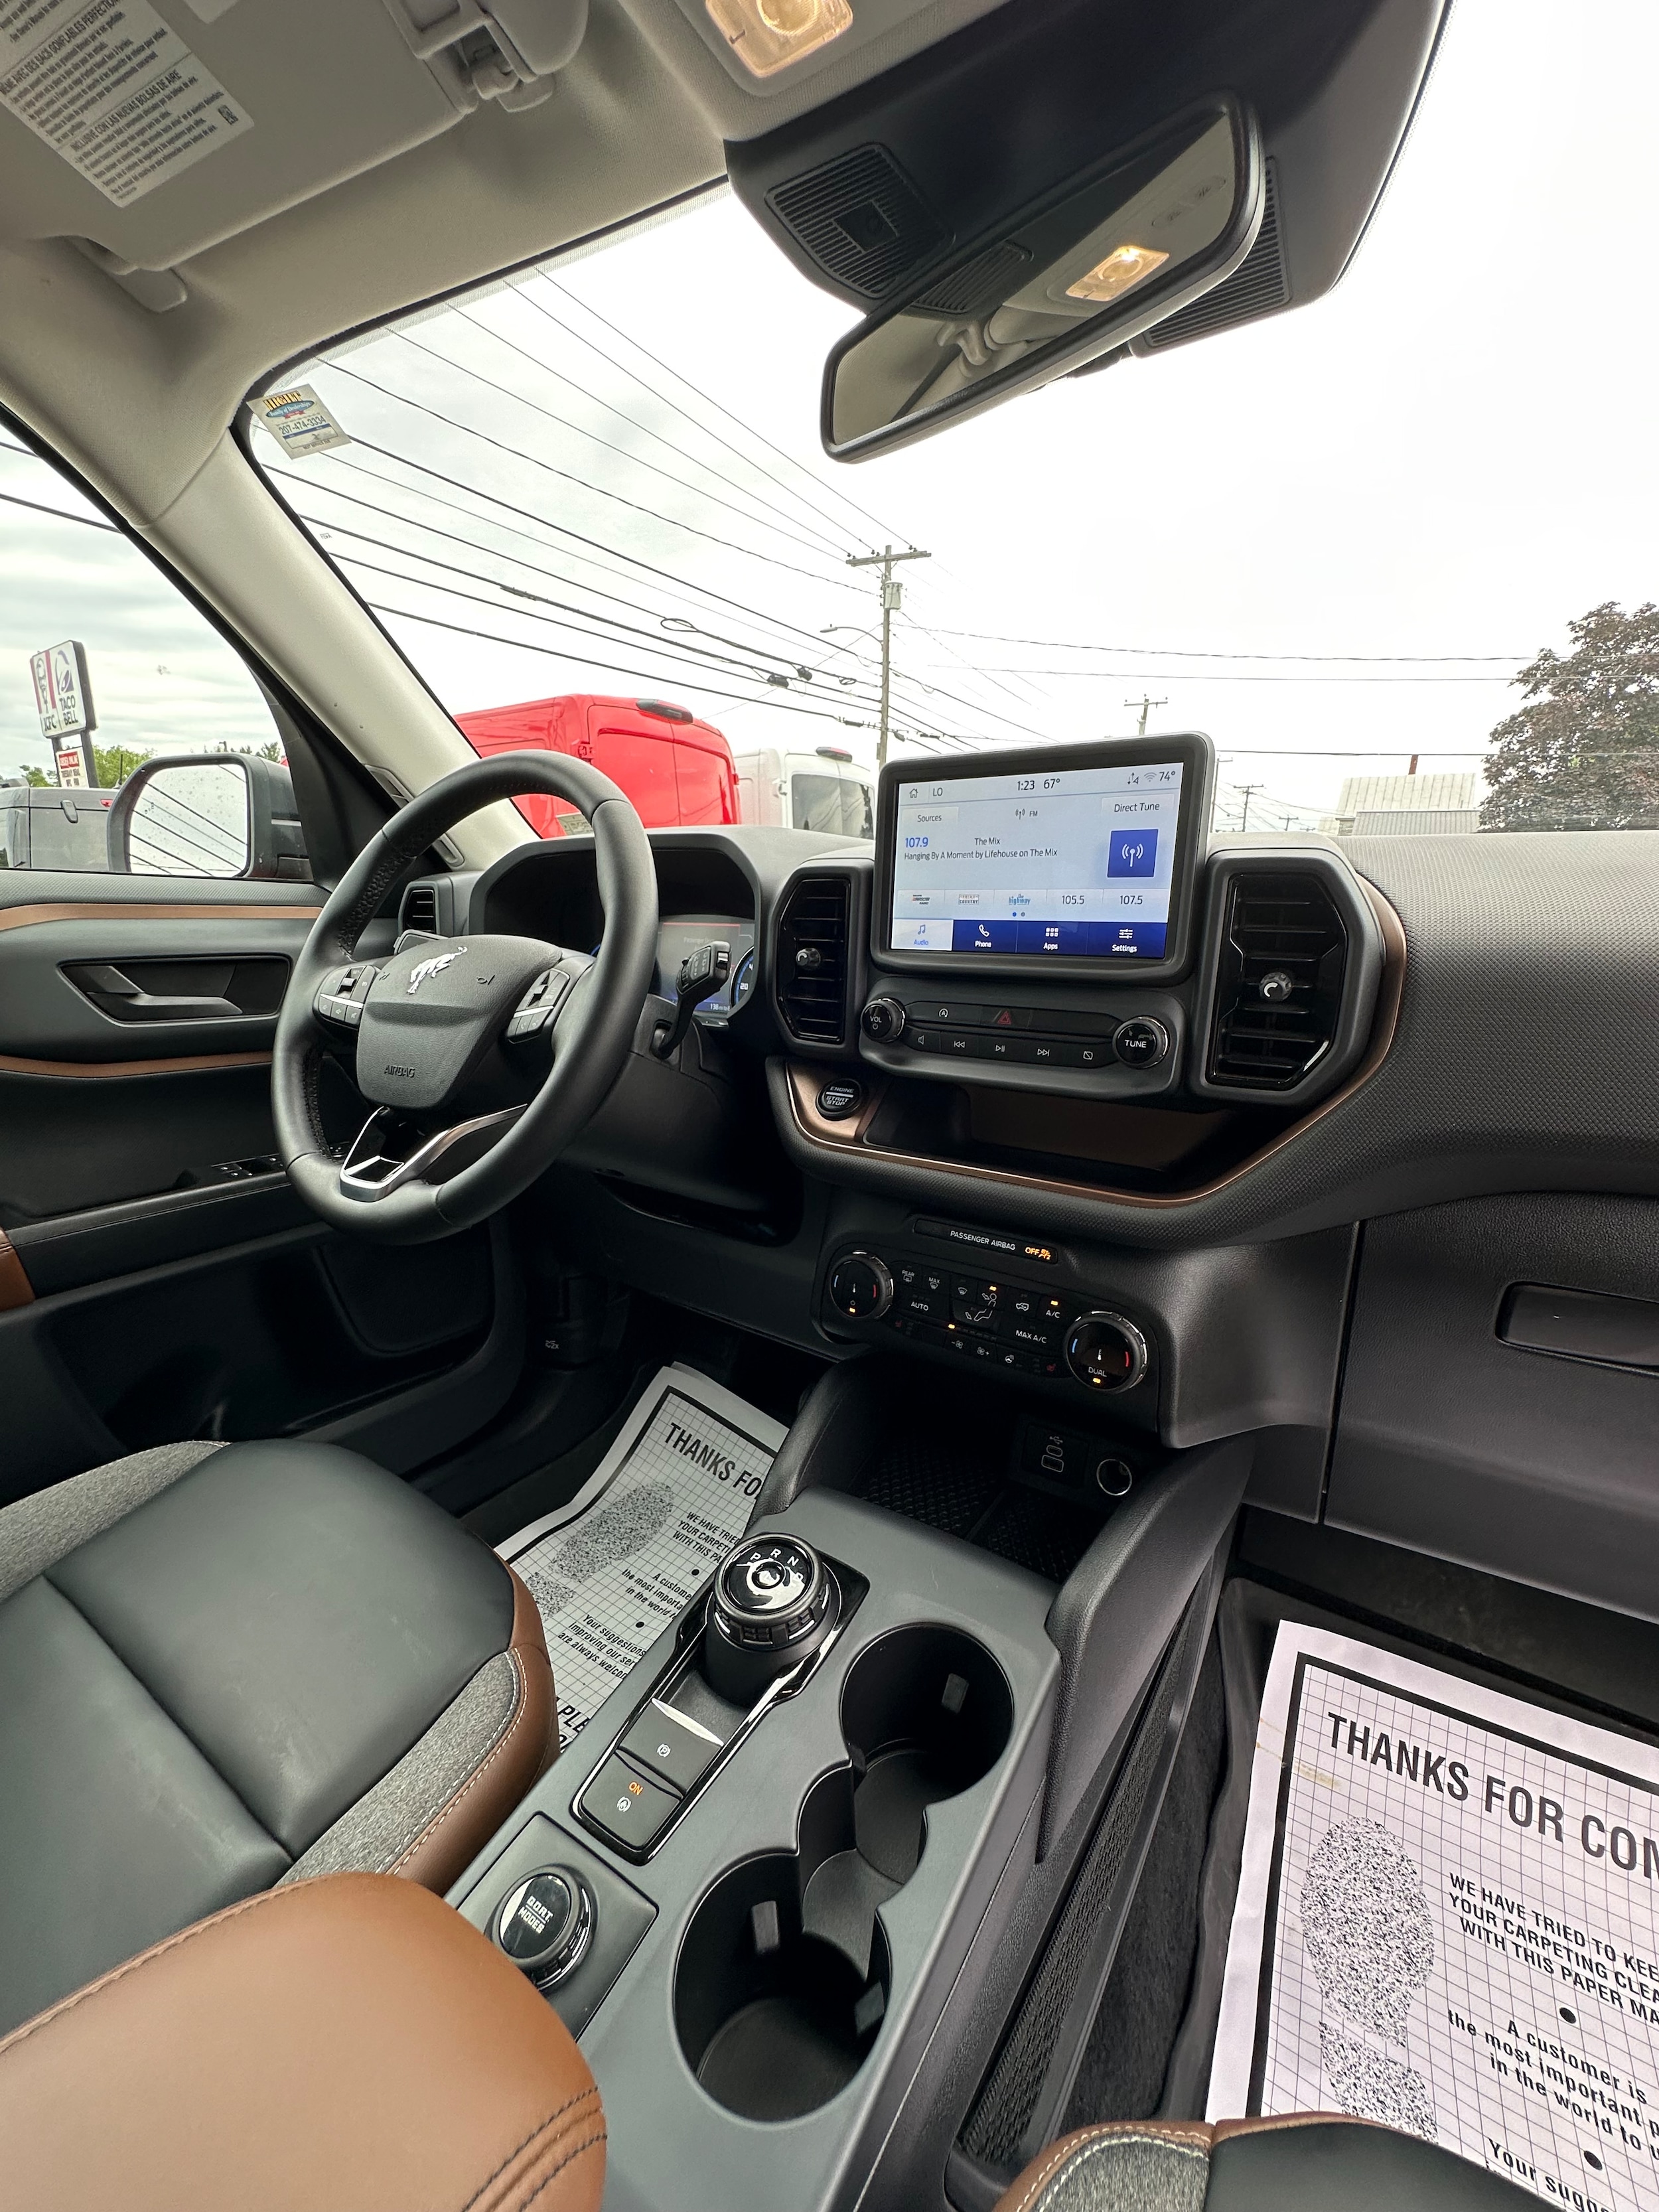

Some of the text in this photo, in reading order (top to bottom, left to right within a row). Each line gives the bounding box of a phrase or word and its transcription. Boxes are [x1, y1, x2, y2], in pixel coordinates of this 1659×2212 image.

[95, 122, 108, 134] CON
[106, 113, 119, 127] LAS
[115, 100, 139, 121] NUEVAS
[135, 86, 160, 106] BOLSAS
[155, 80, 167, 91] DE
[165, 69, 182, 85] AIRE
[279, 415, 326, 435] 207-474-3334
[59, 695, 76, 711] TACO
[43, 714, 56, 731] KFC
[63, 710, 78, 725] BELL
[932, 771, 1175, 796] LO 1:23 67° 74°
[1114, 802, 1159, 812] Direct Tune
[904, 837, 928, 848] 107.9
[988, 837, 1001, 846] Mix
[904, 851, 930, 861] Hanging
[931, 851, 940, 861] By
[946, 851, 974, 859] Moment
[975, 849, 983, 859] by
[985, 849, 1017, 858] Lifehouse
[1045, 848, 1058, 857] Mix
[1009, 896, 1031, 905] highway
[1062, 895, 1084, 905] 105.5
[1120, 895, 1143, 905] 107.5
[1112, 944, 1137, 953] Settings
[1124, 1040, 1147, 1049] TUNE
[384, 1064, 415, 1078] AIRBAG
[950, 1230, 1039, 1256] PASSENGER AIRBAG OFF
[911, 1301, 928, 1311] AUTO
[1016, 1330, 1046, 1343] MAX A/C
[1088, 1367, 1107, 1377] DUAL
[665, 1422, 762, 1500] THANKS FO
[678, 1520, 699, 1536] YOUR
[686, 1511, 700, 1523] WE
[698, 1518, 720, 1534] HAVE
[673, 1531, 722, 1563] WITH THIS PA
[750, 1552, 761, 1560] P
[770, 1548, 781, 1558] R
[787, 1556, 799, 1566] N
[622, 1569, 684, 1610] the most importa
[625, 1585, 634, 1595] in
[634, 1591, 648, 1603] the
[647, 1600, 672, 1615] world
[660, 1578, 692, 1600] custome
[558, 1632, 573, 1644] are
[571, 1641, 600, 1662] always
[569, 1622, 607, 1651] improving
[606, 1647, 622, 1659] our
[583, 1615, 647, 1657] Your suggestions
[628, 1782, 644, 1795] ON
[1327, 1712, 1469, 1801] THANKS
[1485, 1775, 1563, 1843] FOR
[518, 1907, 545, 1934] MODES
[1449, 1872, 1659, 1983] WE HAVE TRIED TO KEE
[1449, 1892, 1497, 1927] YOUR
[1504, 1919, 1608, 1980] CARPETING
[1459, 1916, 1659, 2026] WITH THIS PAPER MA
[1448, 2009, 1477, 2037] the
[1485, 2031, 1532, 2067] most
[1539, 2057, 1642, 2127] important
[1507, 2020, 1647, 2105] A customer is
[1490, 2052, 1508, 2076] in
[1515, 2067, 1548, 2097] the
[1553, 2091, 1613, 2136] world
[1620, 2124, 1642, 2151] to
[1488, 2138, 1536, 2181] Your
